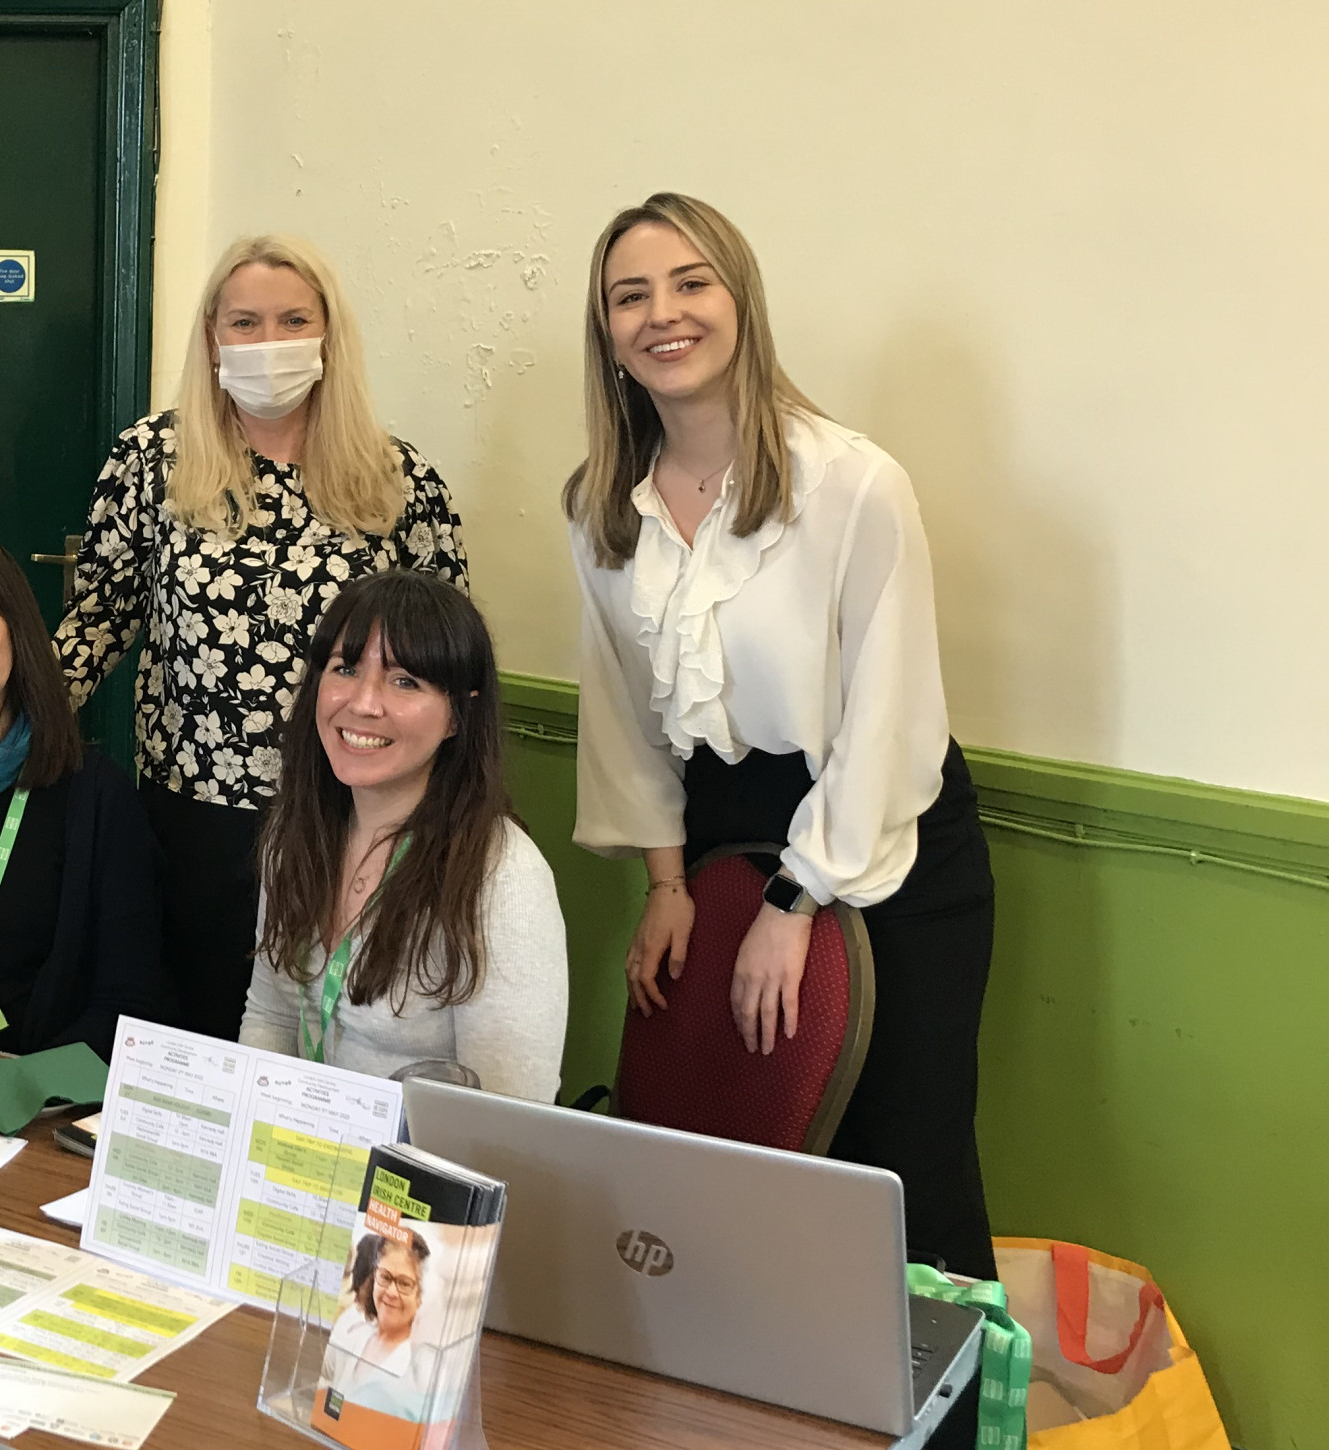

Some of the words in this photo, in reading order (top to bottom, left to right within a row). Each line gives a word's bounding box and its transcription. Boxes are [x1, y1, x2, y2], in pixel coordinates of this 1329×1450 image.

[375, 1169, 406, 1192] LONDON
[369, 1199, 398, 1222] HEALTH
[372, 1184, 392, 1202] IRISH
[393, 1195, 427, 1218] CENTRE
[365, 1213, 409, 1244] NAVIGATOR
[624, 1229, 668, 1275] hp
